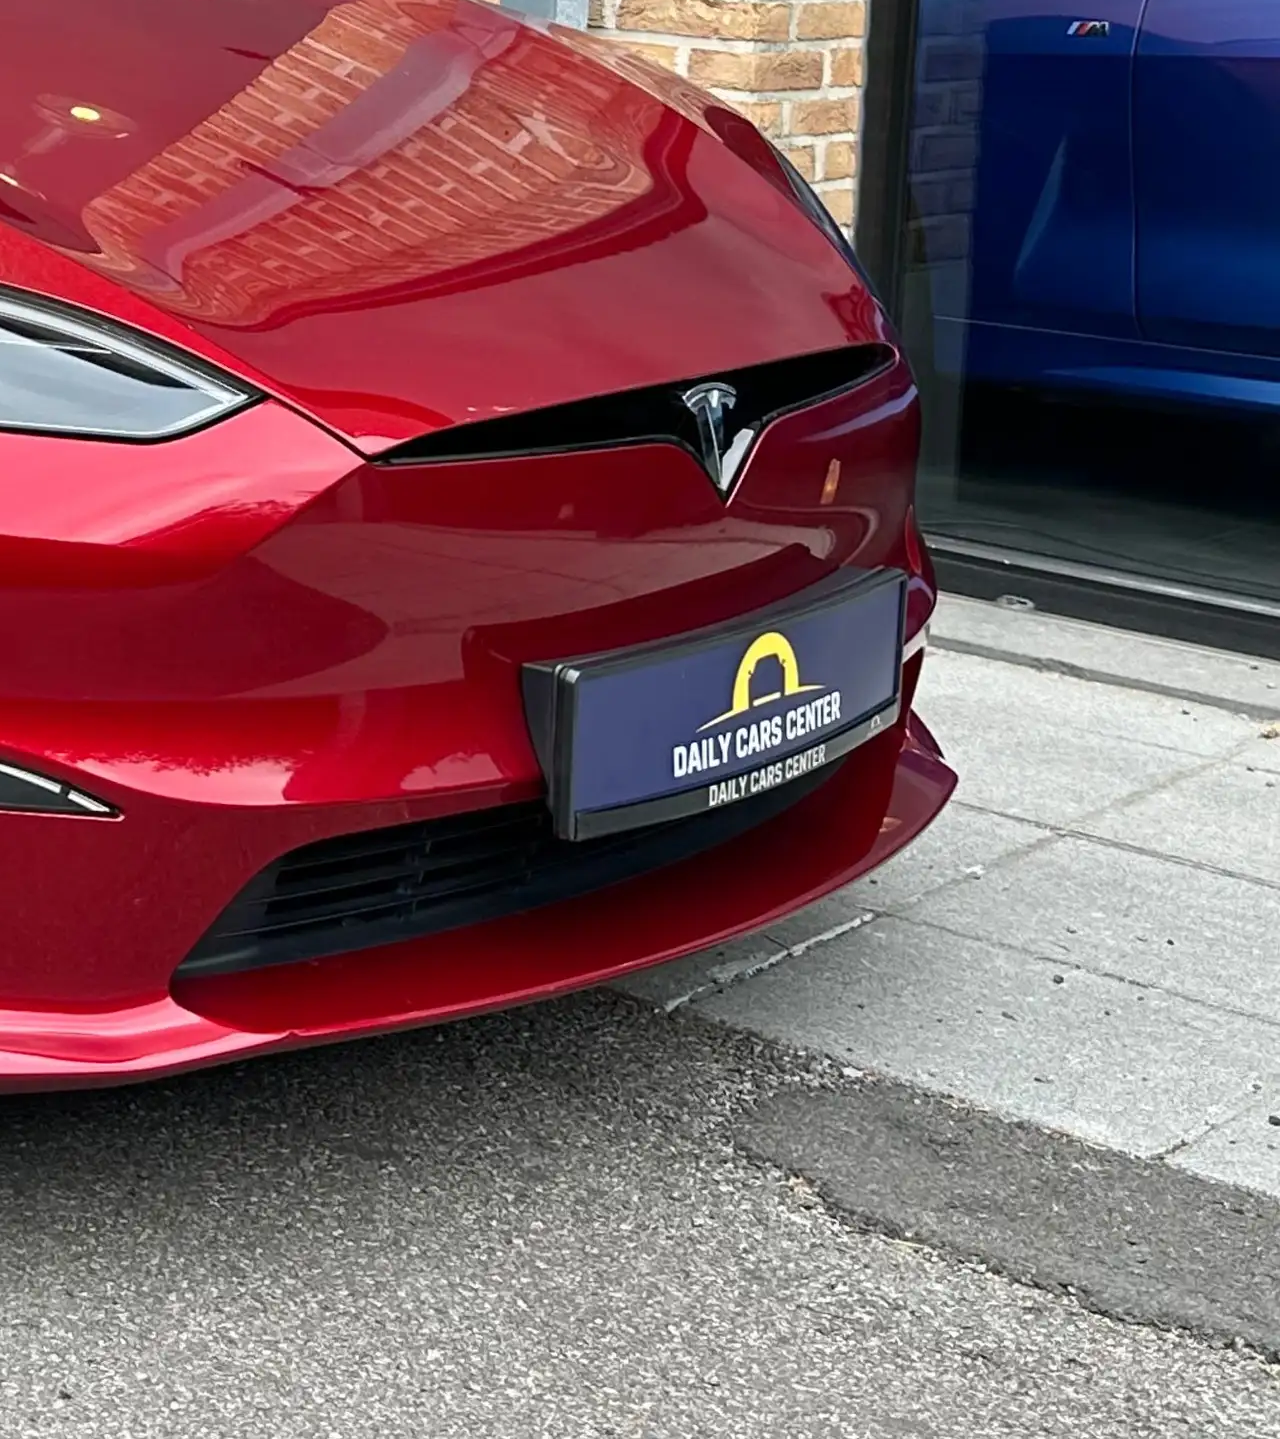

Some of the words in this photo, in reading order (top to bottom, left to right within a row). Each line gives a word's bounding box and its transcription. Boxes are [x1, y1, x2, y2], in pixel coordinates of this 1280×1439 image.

[673, 732, 730, 778] DAILY
[735, 717, 782, 759] CARS
[786, 691, 841, 741] CENTER
[708, 775, 747, 806] DAILY
[750, 762, 784, 793] CARS
[784, 744, 826, 781] CENTER
